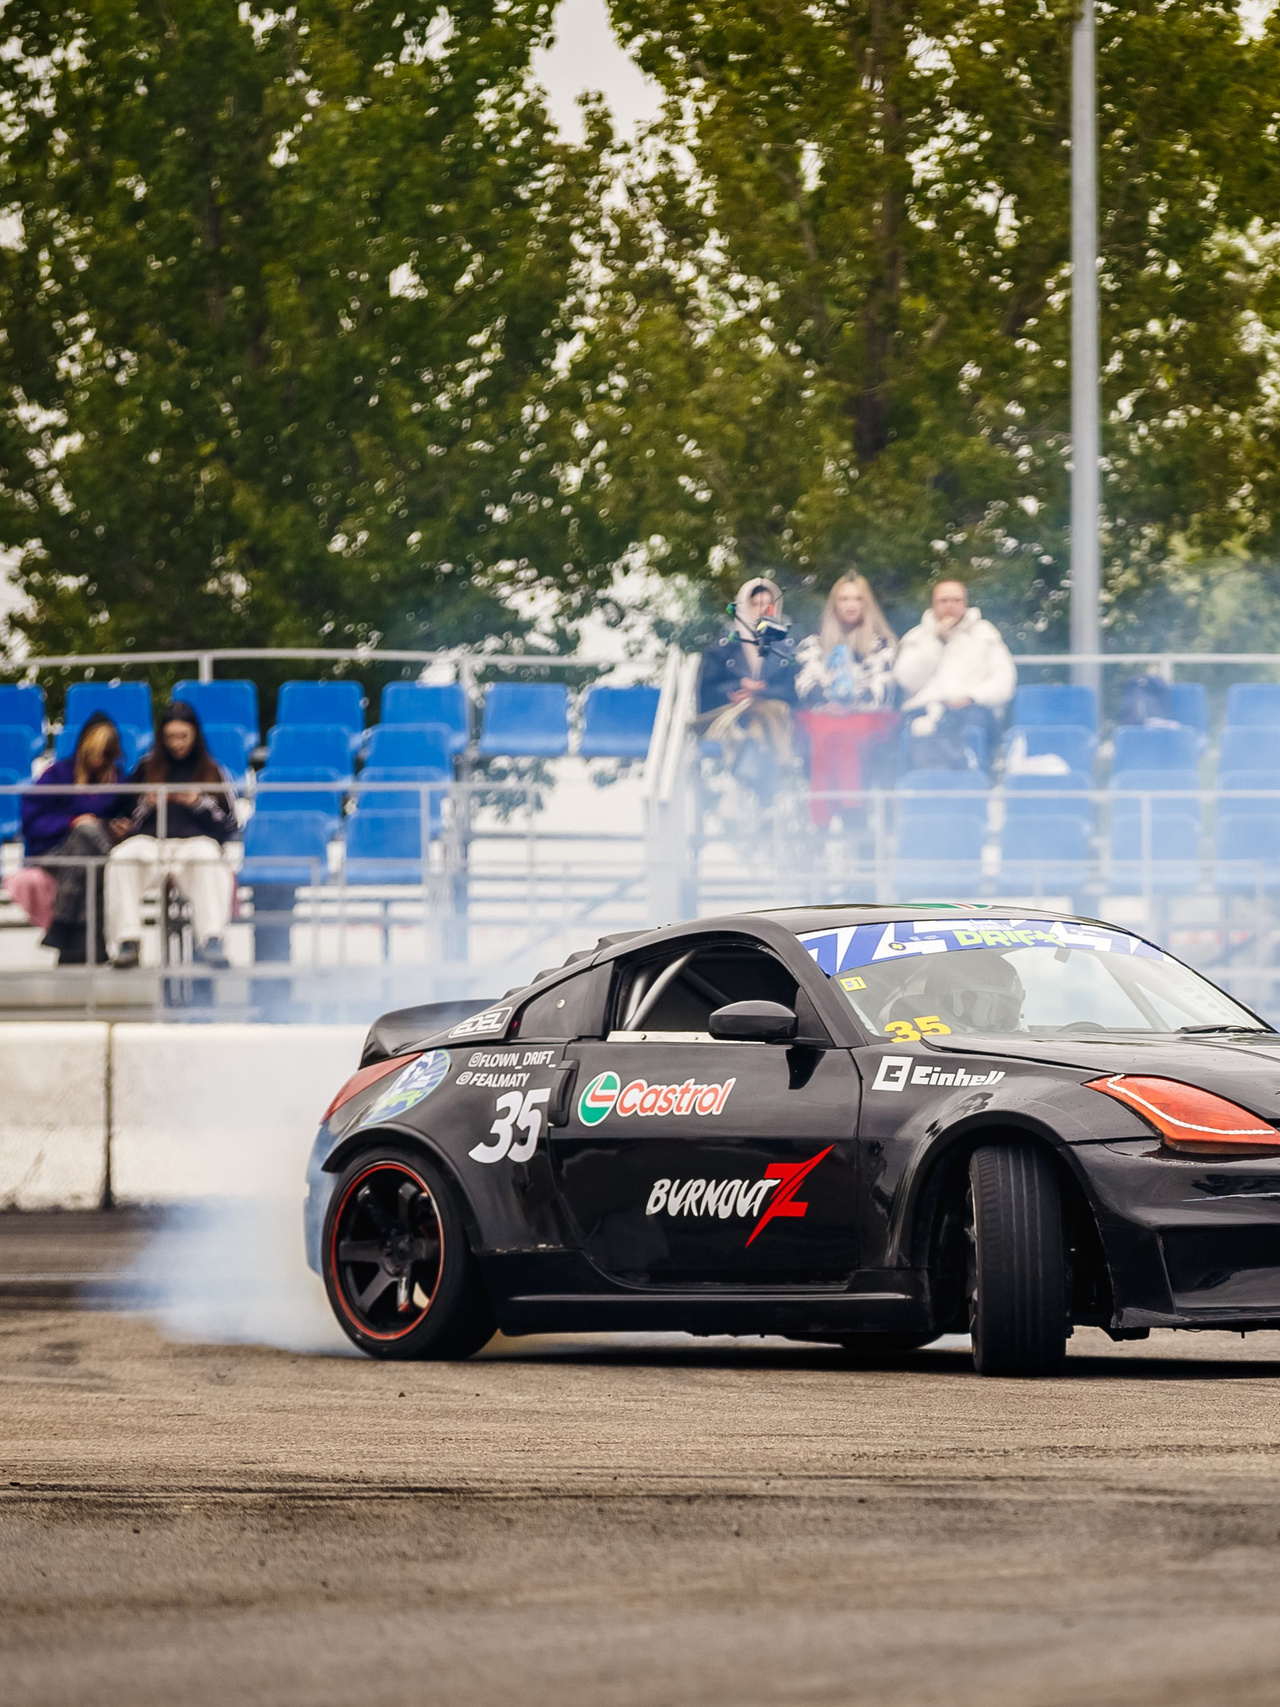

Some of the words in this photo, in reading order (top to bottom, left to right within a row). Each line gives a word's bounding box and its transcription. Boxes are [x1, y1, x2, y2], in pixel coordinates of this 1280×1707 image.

[884, 1015, 952, 1043] 35
[910, 1065, 1006, 1087] Einhell
[616, 1077, 737, 1118] Castrol
[467, 1087, 552, 1164] 35
